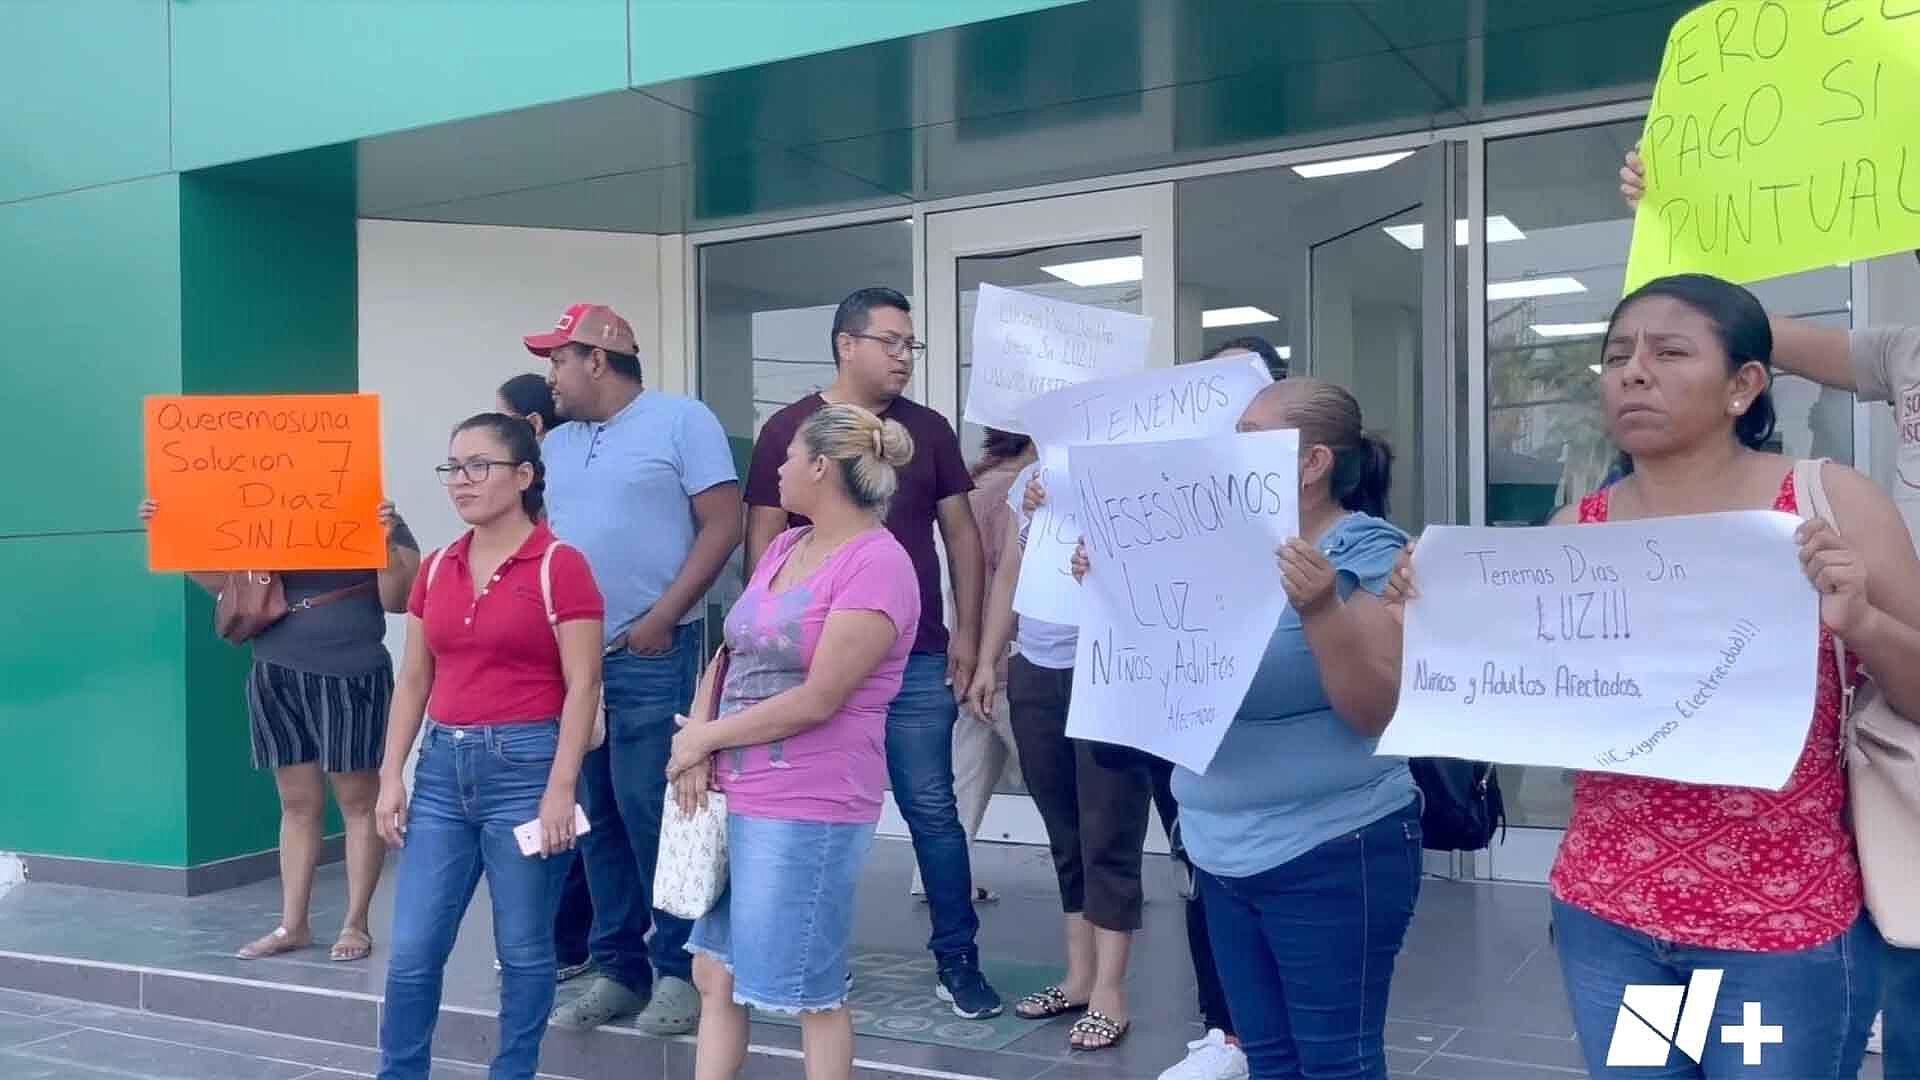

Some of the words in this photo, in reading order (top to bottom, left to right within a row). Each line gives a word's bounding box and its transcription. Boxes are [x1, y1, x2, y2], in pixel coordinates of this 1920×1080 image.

[1649, 83, 1783, 190] PAGO
[1818, 59, 1882, 126] SI
[1658, 147, 1920, 264] PUNTUAL
[1071, 374, 1229, 441] TENEMOS
[286, 519, 374, 555] LUZ
[1463, 549, 1554, 586] Tenemos
[1561, 543, 1618, 584] Dias
[1645, 538, 1687, 582] Sin
[1122, 562, 1209, 632] LUZ
[1535, 588, 1632, 641] LUZ!!!
[1412, 657, 1457, 693] Niños
[1463, 675, 1477, 705] y
[1481, 659, 1547, 697] Adultos
